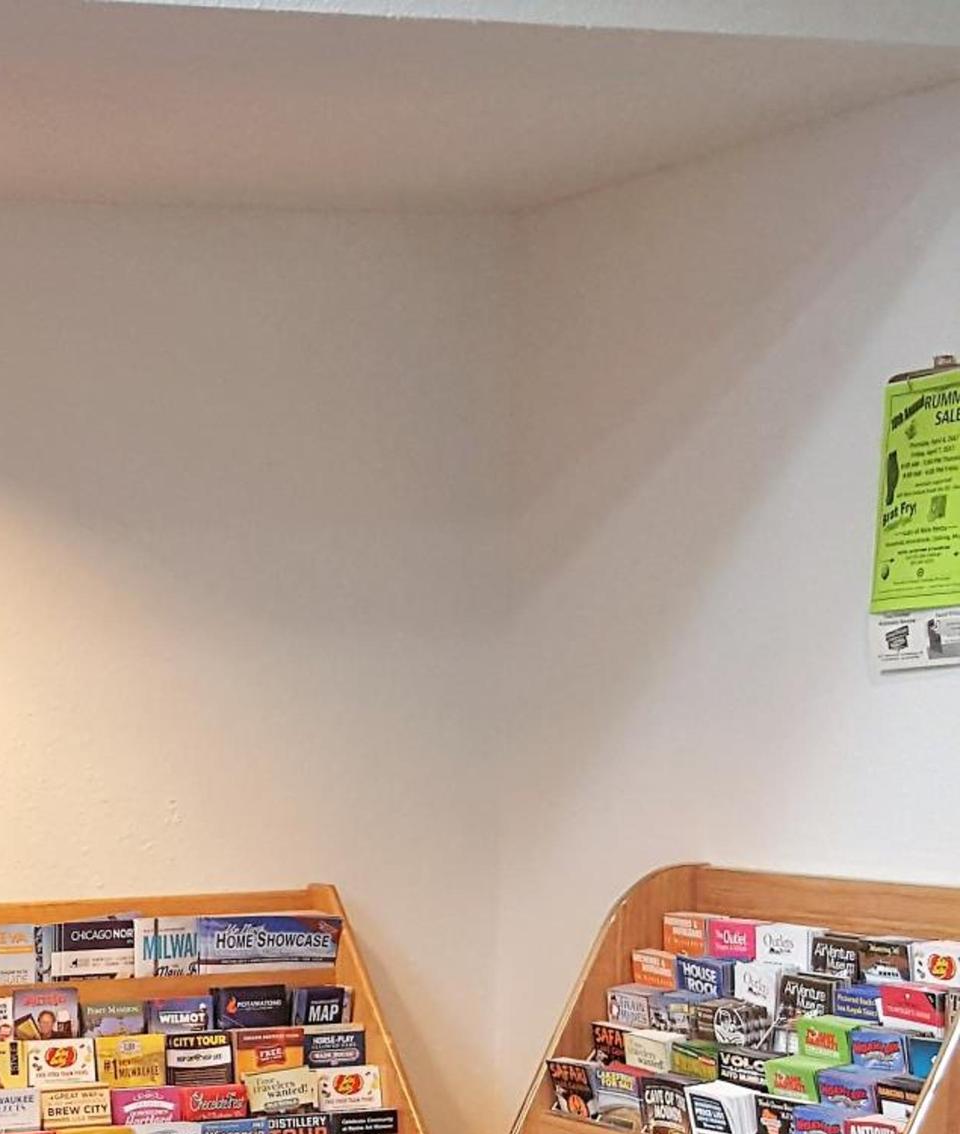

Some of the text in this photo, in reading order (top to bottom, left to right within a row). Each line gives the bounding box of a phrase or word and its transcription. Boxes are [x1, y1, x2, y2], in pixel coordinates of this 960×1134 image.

[216, 931, 330, 948] HOME SHOWCASE
[682, 962, 716, 982] HOUSE
[159, 1012, 205, 1024] WILMOT
[308, 1004, 339, 1022] MAP
[173, 1034, 226, 1047] CITY TOUR
[47, 1104, 108, 1117] BREW CITY
[269, 1116, 326, 1129] DISTILLERY
